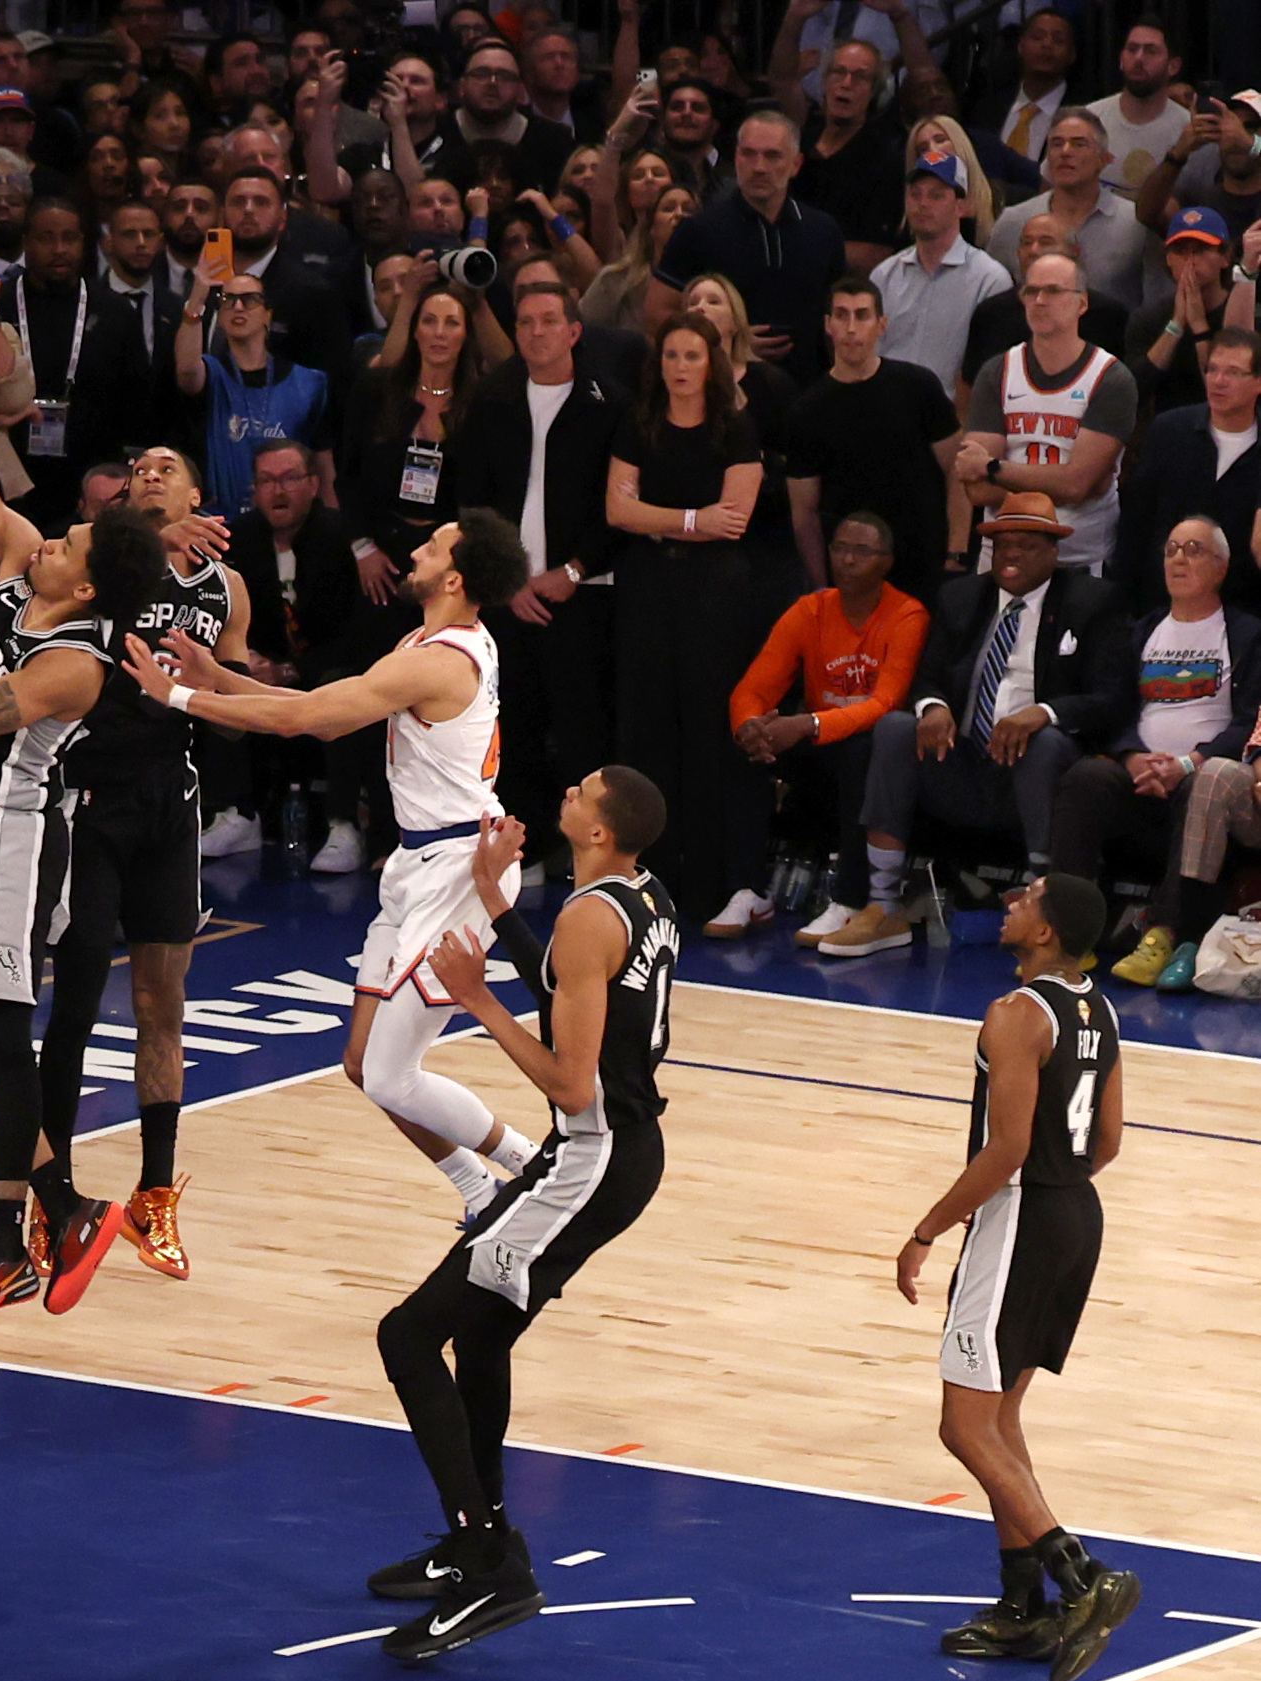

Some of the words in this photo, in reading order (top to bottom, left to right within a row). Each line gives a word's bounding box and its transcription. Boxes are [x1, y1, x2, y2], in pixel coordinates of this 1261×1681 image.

[135, 603, 223, 647] SPURS
[1076, 1029, 1101, 1060] FOX
[1067, 1070, 1097, 1156] 4
